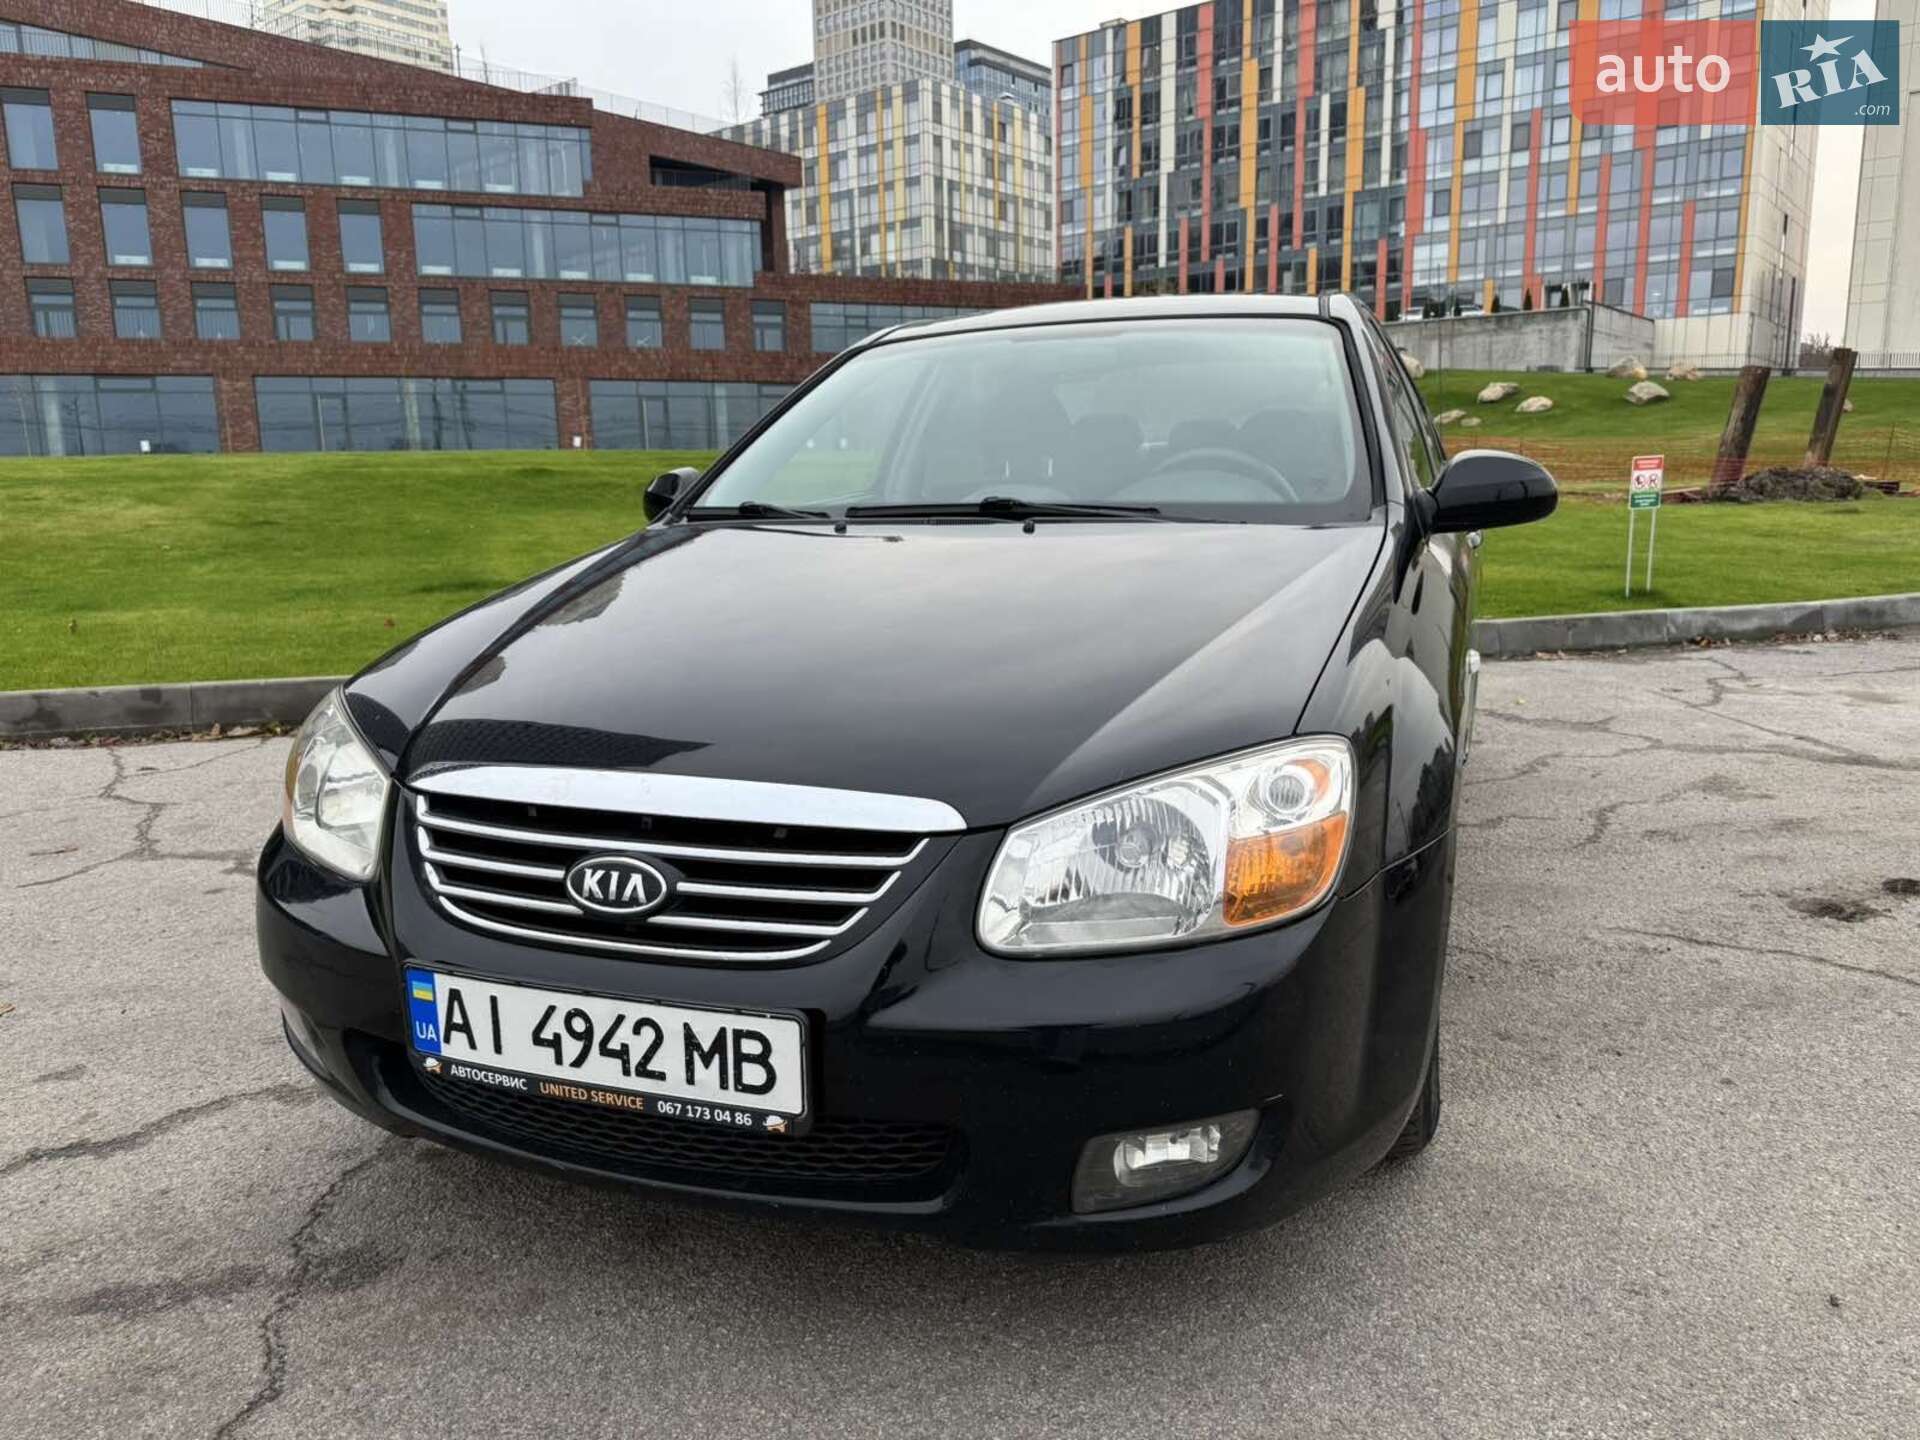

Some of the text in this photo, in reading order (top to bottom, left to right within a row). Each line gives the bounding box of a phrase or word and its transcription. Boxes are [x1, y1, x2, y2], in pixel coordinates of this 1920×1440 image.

[582, 868, 647, 904] KIA
[416, 1022, 438, 1042] UA
[443, 988, 777, 1095] AI 4942 MB
[450, 1064, 528, 1092] АВТОСЕРВИС
[540, 1081, 645, 1111] UNITED SERVICE
[657, 1100, 752, 1126] 067 173 04 86
